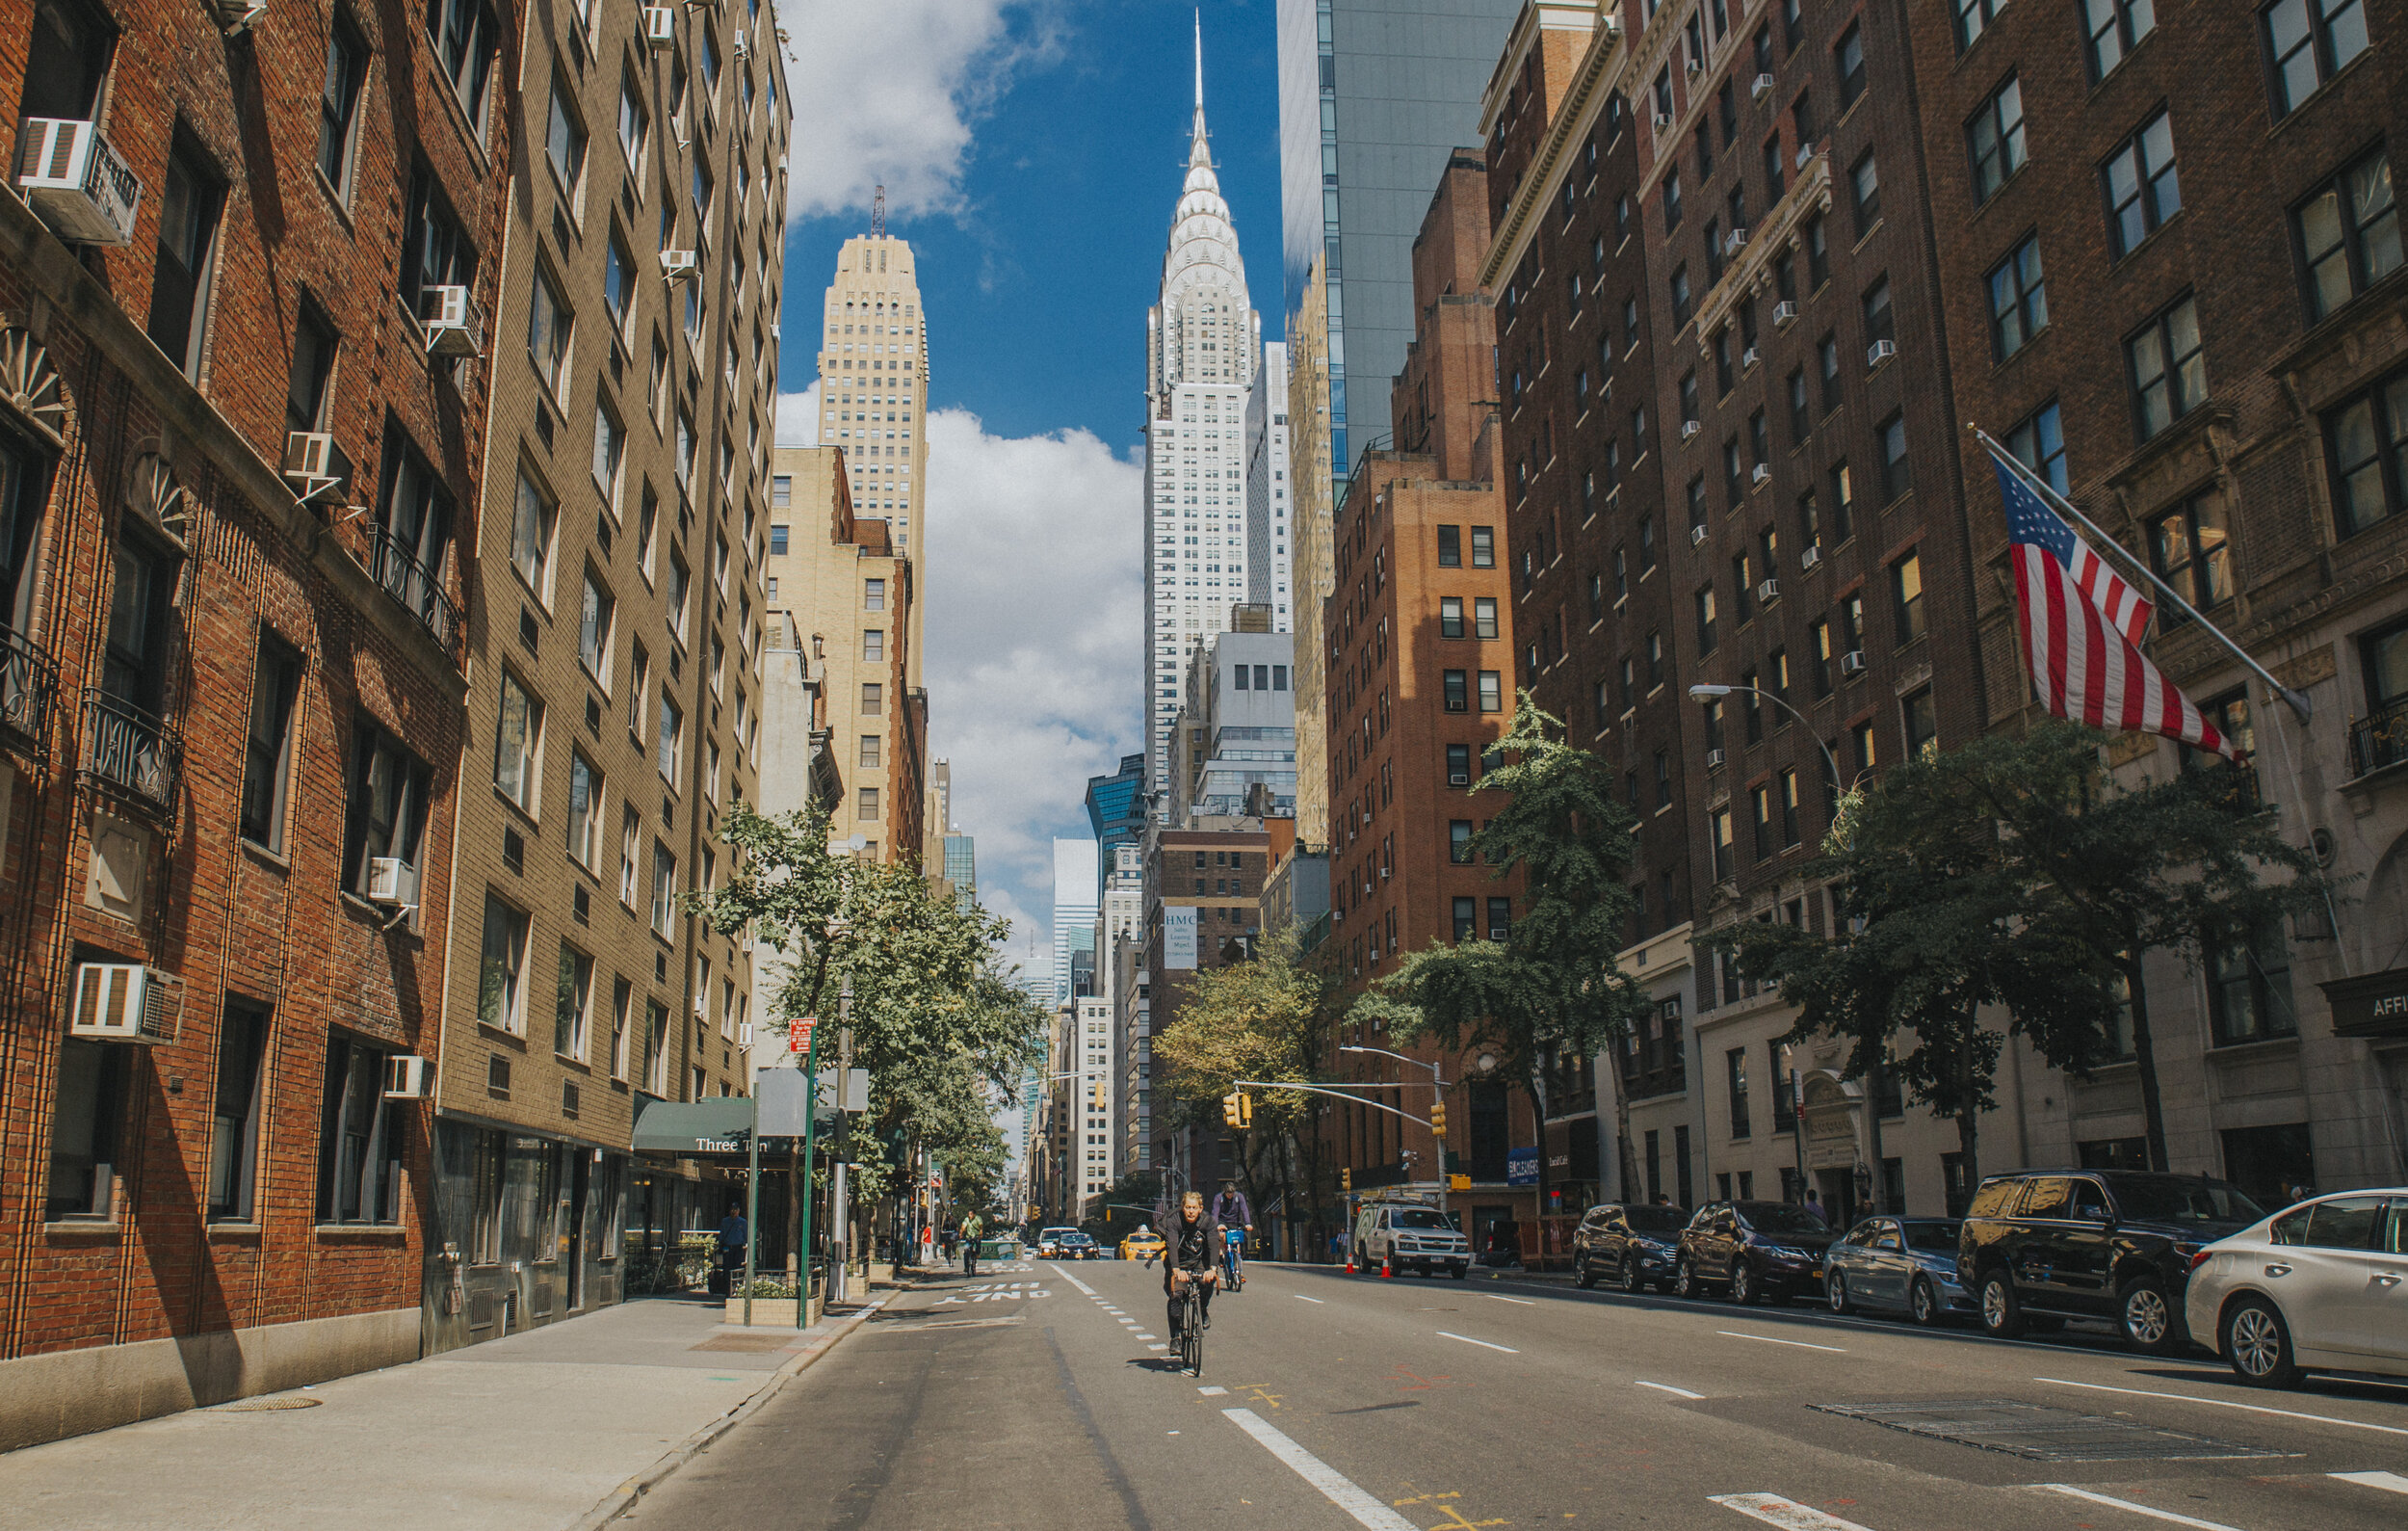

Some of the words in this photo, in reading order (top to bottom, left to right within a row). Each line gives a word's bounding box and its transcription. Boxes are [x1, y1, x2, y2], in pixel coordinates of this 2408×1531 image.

[1165, 915, 1196, 925] HMC
[2373, 994, 2408, 1016] AFFI
[695, 1137, 739, 1151] Three
[743, 1139, 769, 1152] Tn
[931, 1290, 1053, 1305] ONLY
